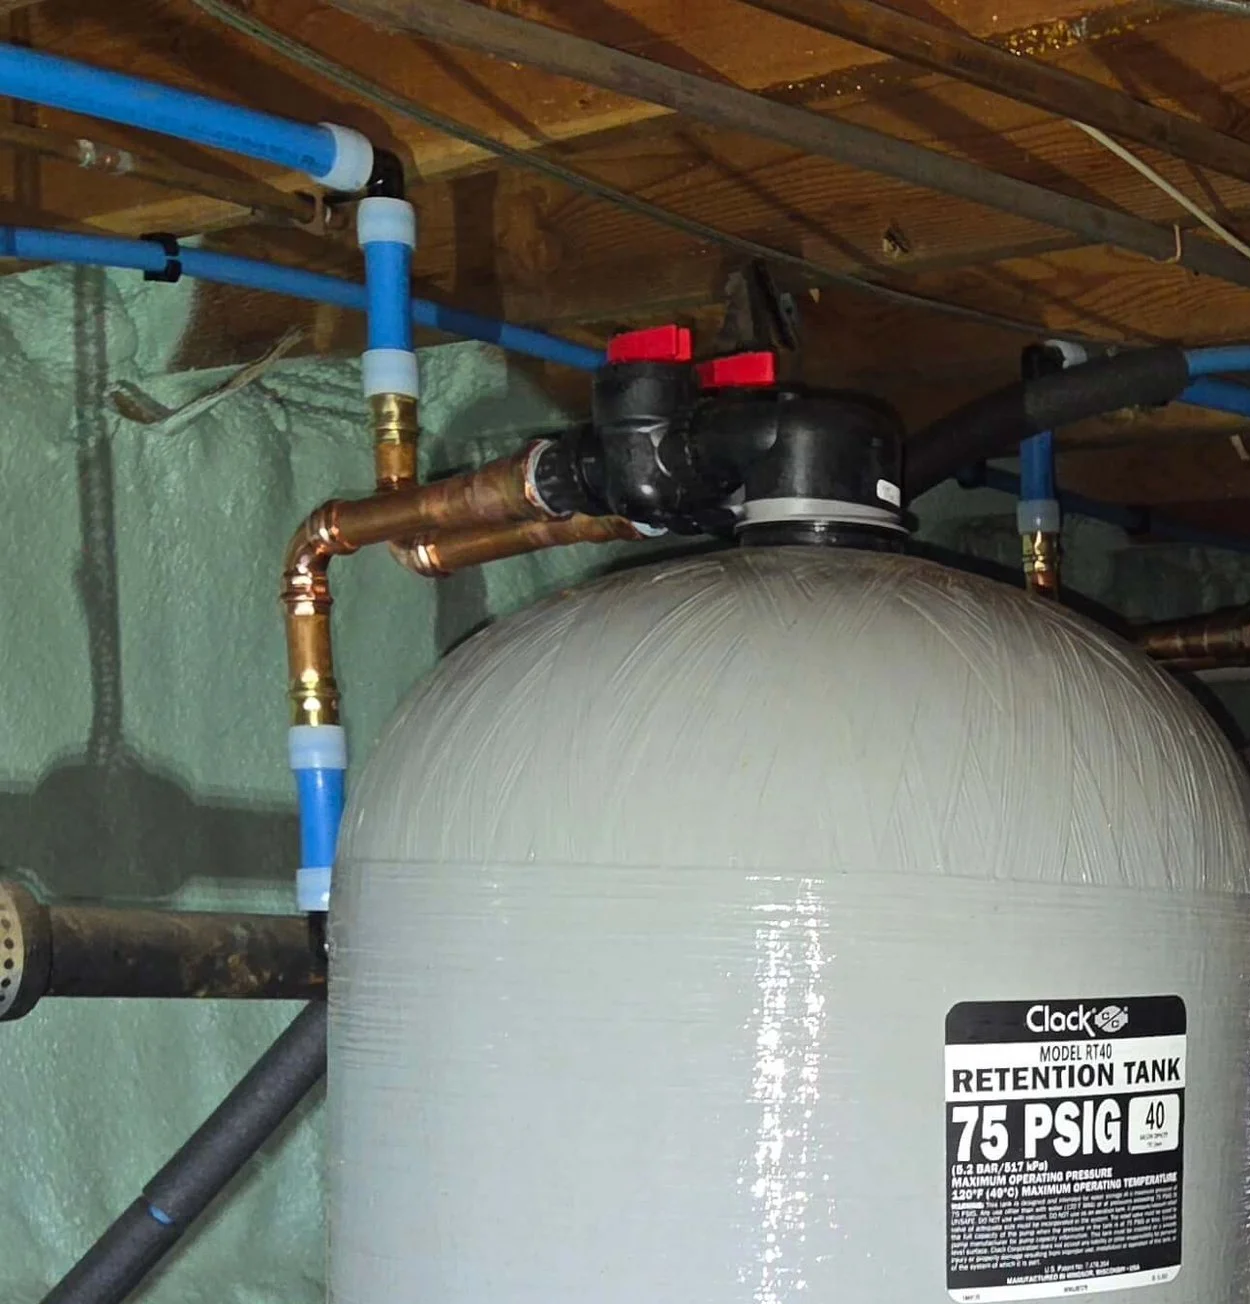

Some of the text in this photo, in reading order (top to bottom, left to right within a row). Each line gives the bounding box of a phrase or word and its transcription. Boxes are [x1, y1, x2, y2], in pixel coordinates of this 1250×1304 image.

[1026, 1004, 1096, 1037] Clack
[1040, 1043, 1112, 1062] MODEL RT40
[952, 1057, 1181, 1093] RETENTION TANK
[1145, 1101, 1165, 1130] 40
[952, 1098, 1122, 1162] 75 PSIG
[951, 1164, 974, 1178] (5.2
[951, 1167, 1113, 1189] MAXIMUM OPERATING PRESSURE
[1021, 1182, 1071, 1197] MAXIMUM
[1073, 1178, 1122, 1193] OPERATING
[1123, 1171, 1178, 1188] TEMPERATURE
[1006, 1273, 1059, 1285] MANUFACTURED
